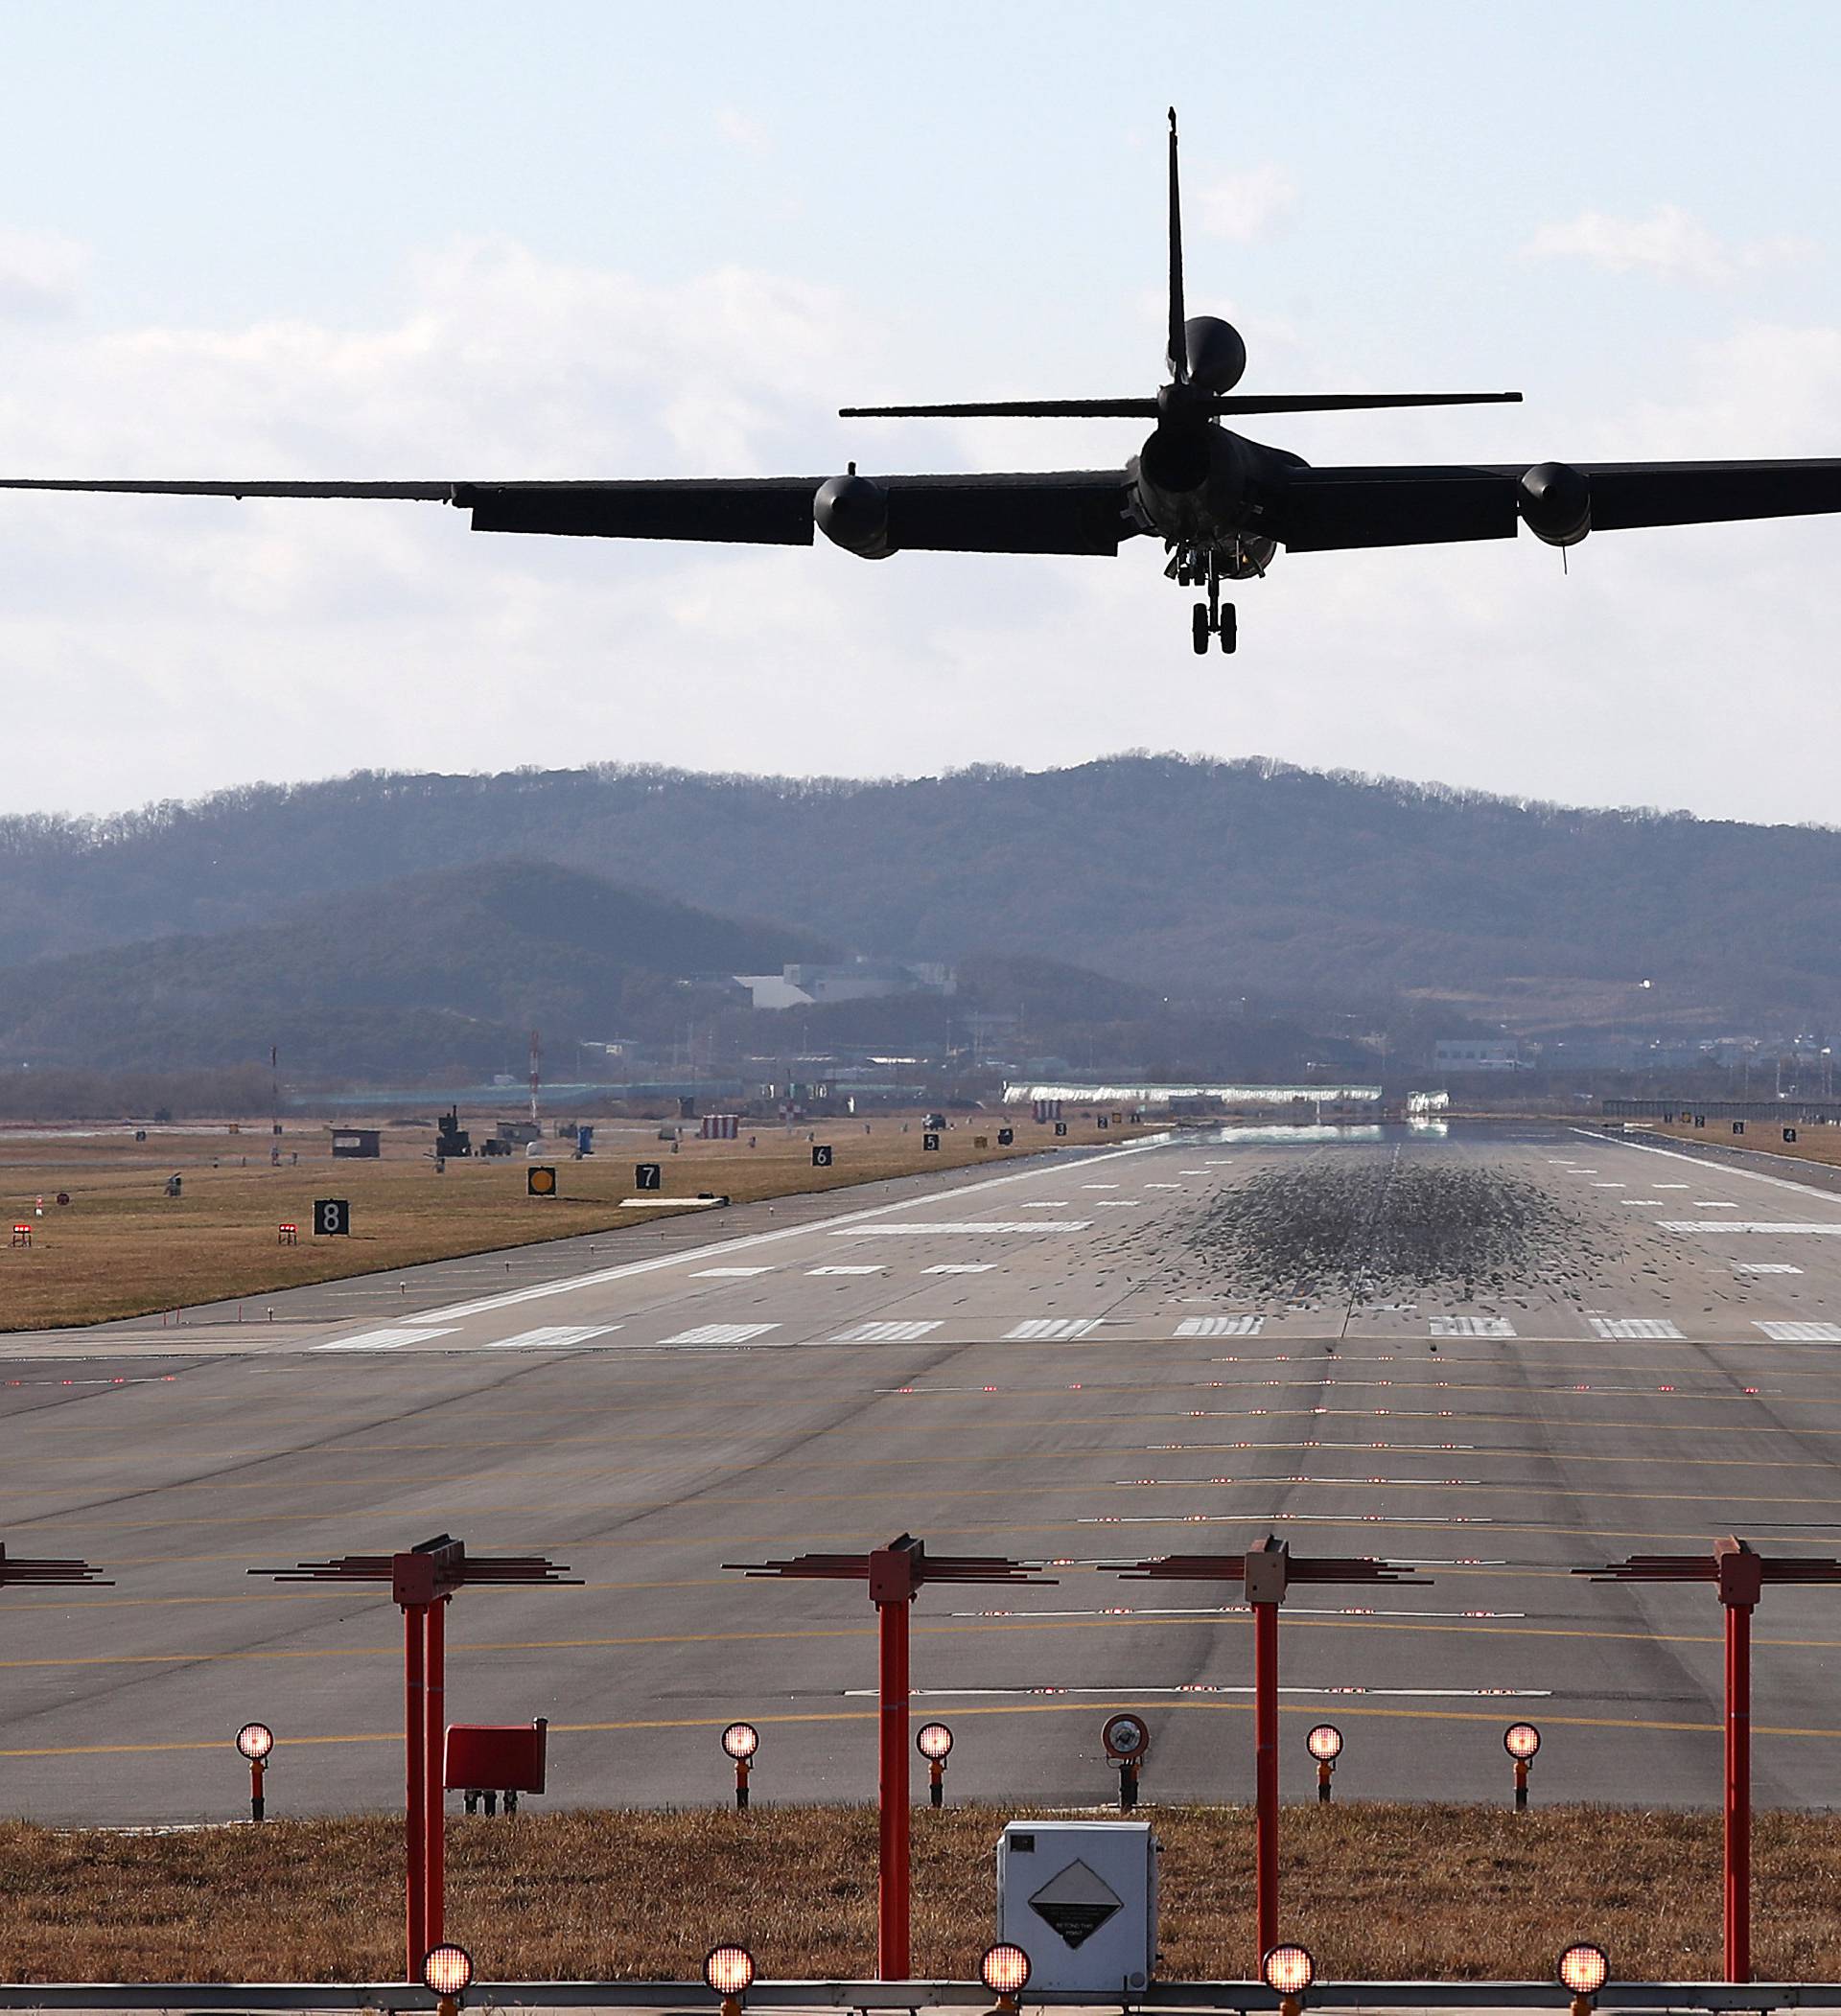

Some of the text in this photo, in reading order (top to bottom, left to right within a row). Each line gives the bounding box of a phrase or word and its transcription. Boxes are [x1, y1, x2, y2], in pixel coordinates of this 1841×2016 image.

[1100, 1118, 1105, 1127] 2
[1697, 1117, 1703, 1127] 2
[1058, 1124, 1063, 1135] 3
[1736, 1124, 1741, 1134] 3
[1786, 1130, 1793, 1141] 4
[927, 1136, 935, 1149] 5
[817, 1148, 827, 1164] 6
[642, 1167, 655, 1187] 7
[323, 1203, 339, 1231] 8
